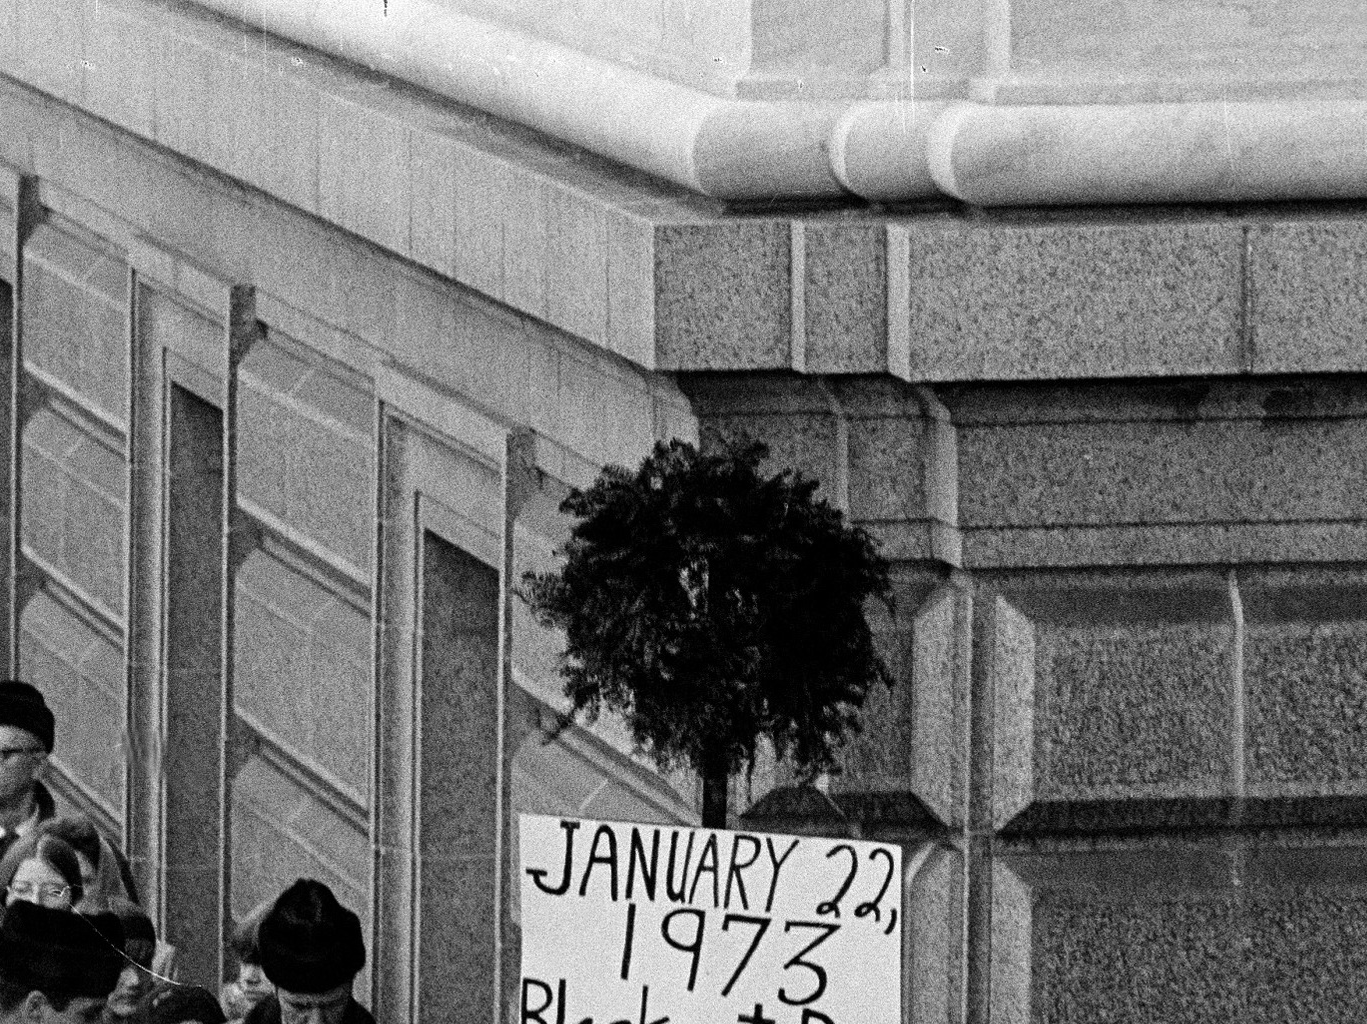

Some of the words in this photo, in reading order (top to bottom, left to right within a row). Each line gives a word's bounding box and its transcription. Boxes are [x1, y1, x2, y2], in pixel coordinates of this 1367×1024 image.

[525, 820, 800, 912] JANUARY
[815, 844, 898, 935] 22,
[620, 902, 842, 1006] 1973
